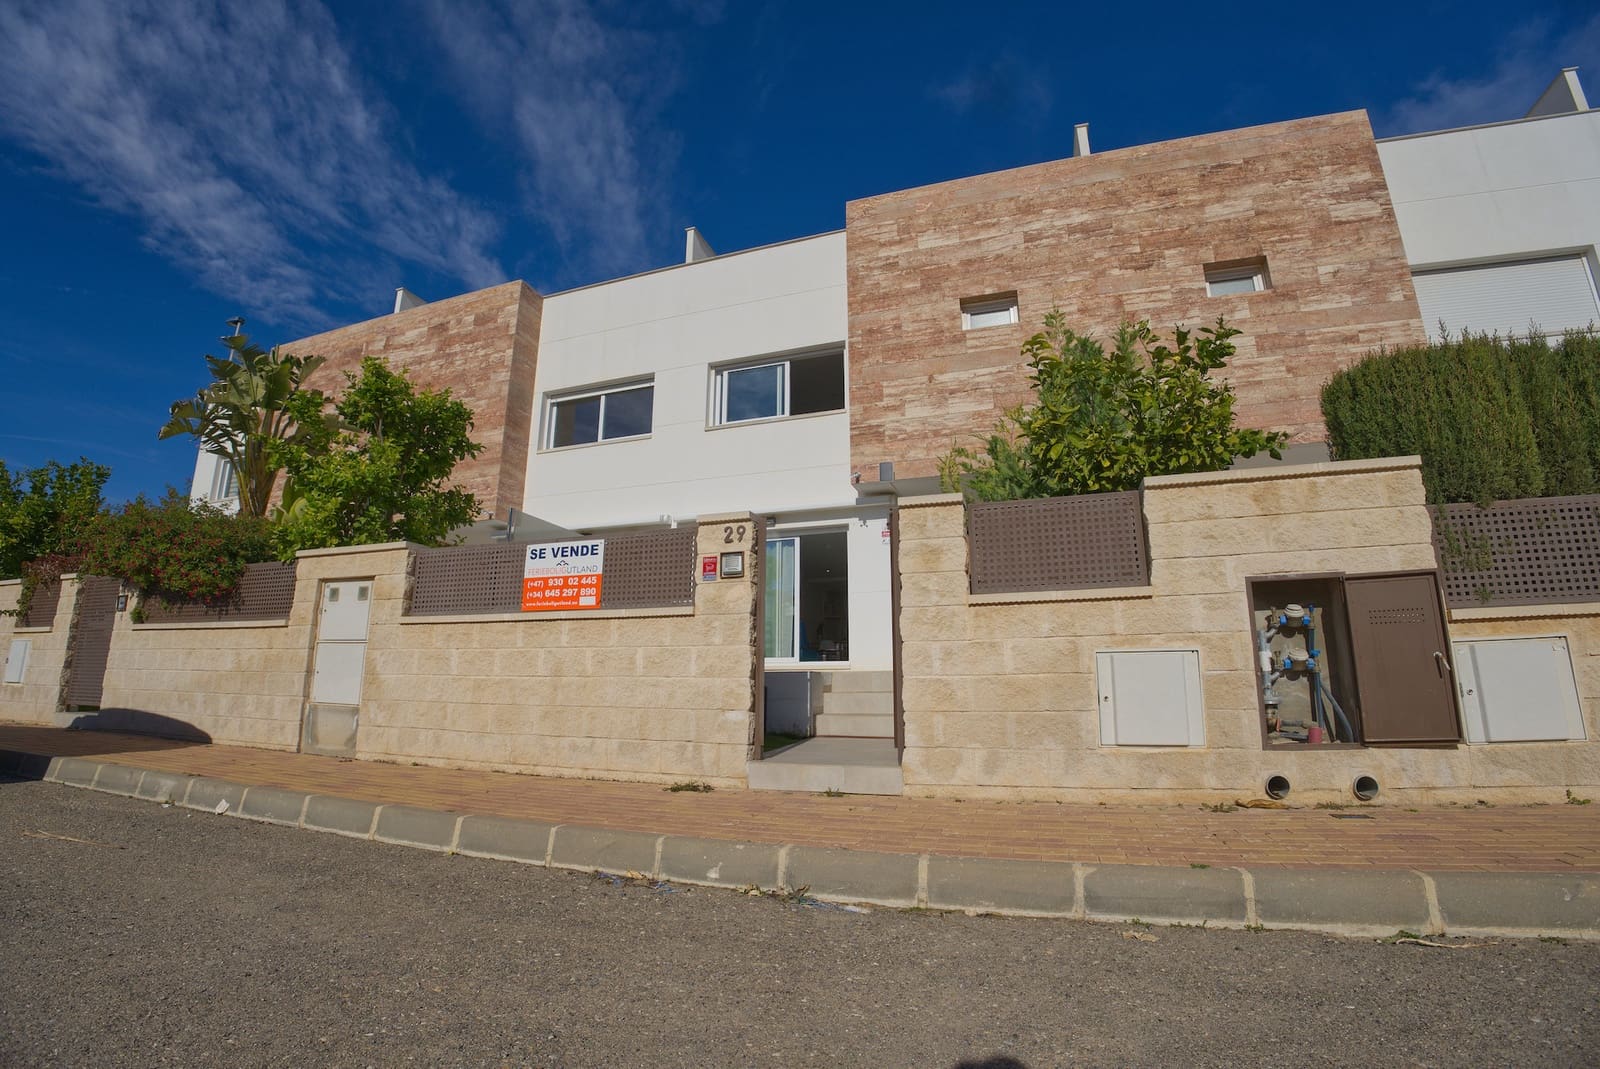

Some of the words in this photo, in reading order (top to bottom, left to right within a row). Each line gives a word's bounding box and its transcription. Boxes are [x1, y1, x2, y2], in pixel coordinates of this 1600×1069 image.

[724, 525, 746, 544] 29
[530, 548, 546, 560] SE
[551, 544, 599, 558] VENDE
[548, 578, 563, 586] 930
[568, 577, 578, 585] 02
[580, 576, 597, 585] 445
[545, 589, 560, 597] 645
[562, 588, 578, 596] 297
[580, 587, 596, 596] 890
